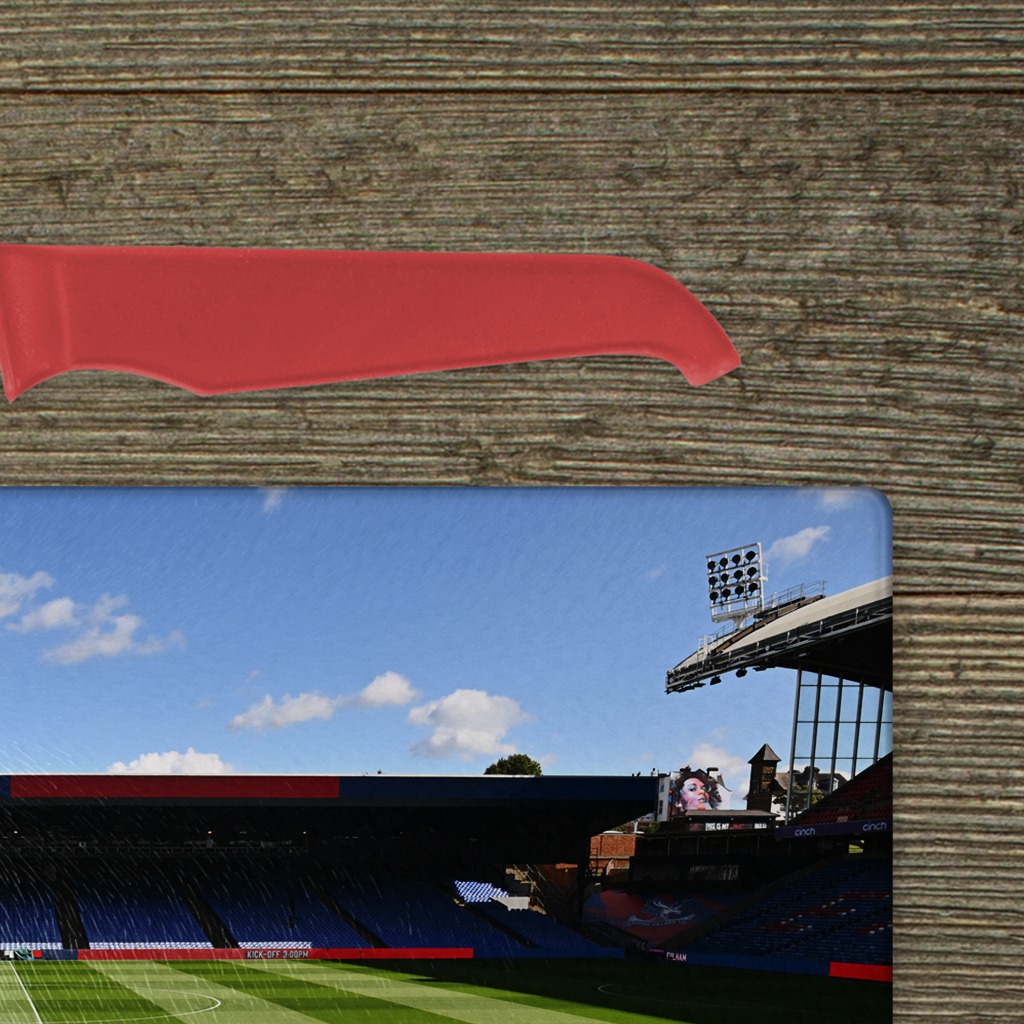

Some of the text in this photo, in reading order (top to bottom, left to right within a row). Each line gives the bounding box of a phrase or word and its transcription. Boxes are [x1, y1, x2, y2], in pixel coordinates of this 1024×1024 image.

[862, 821, 887, 832] cinch
[794, 827, 816, 837] cinch
[246, 950, 309, 959] KICK-OFF 3:00PM
